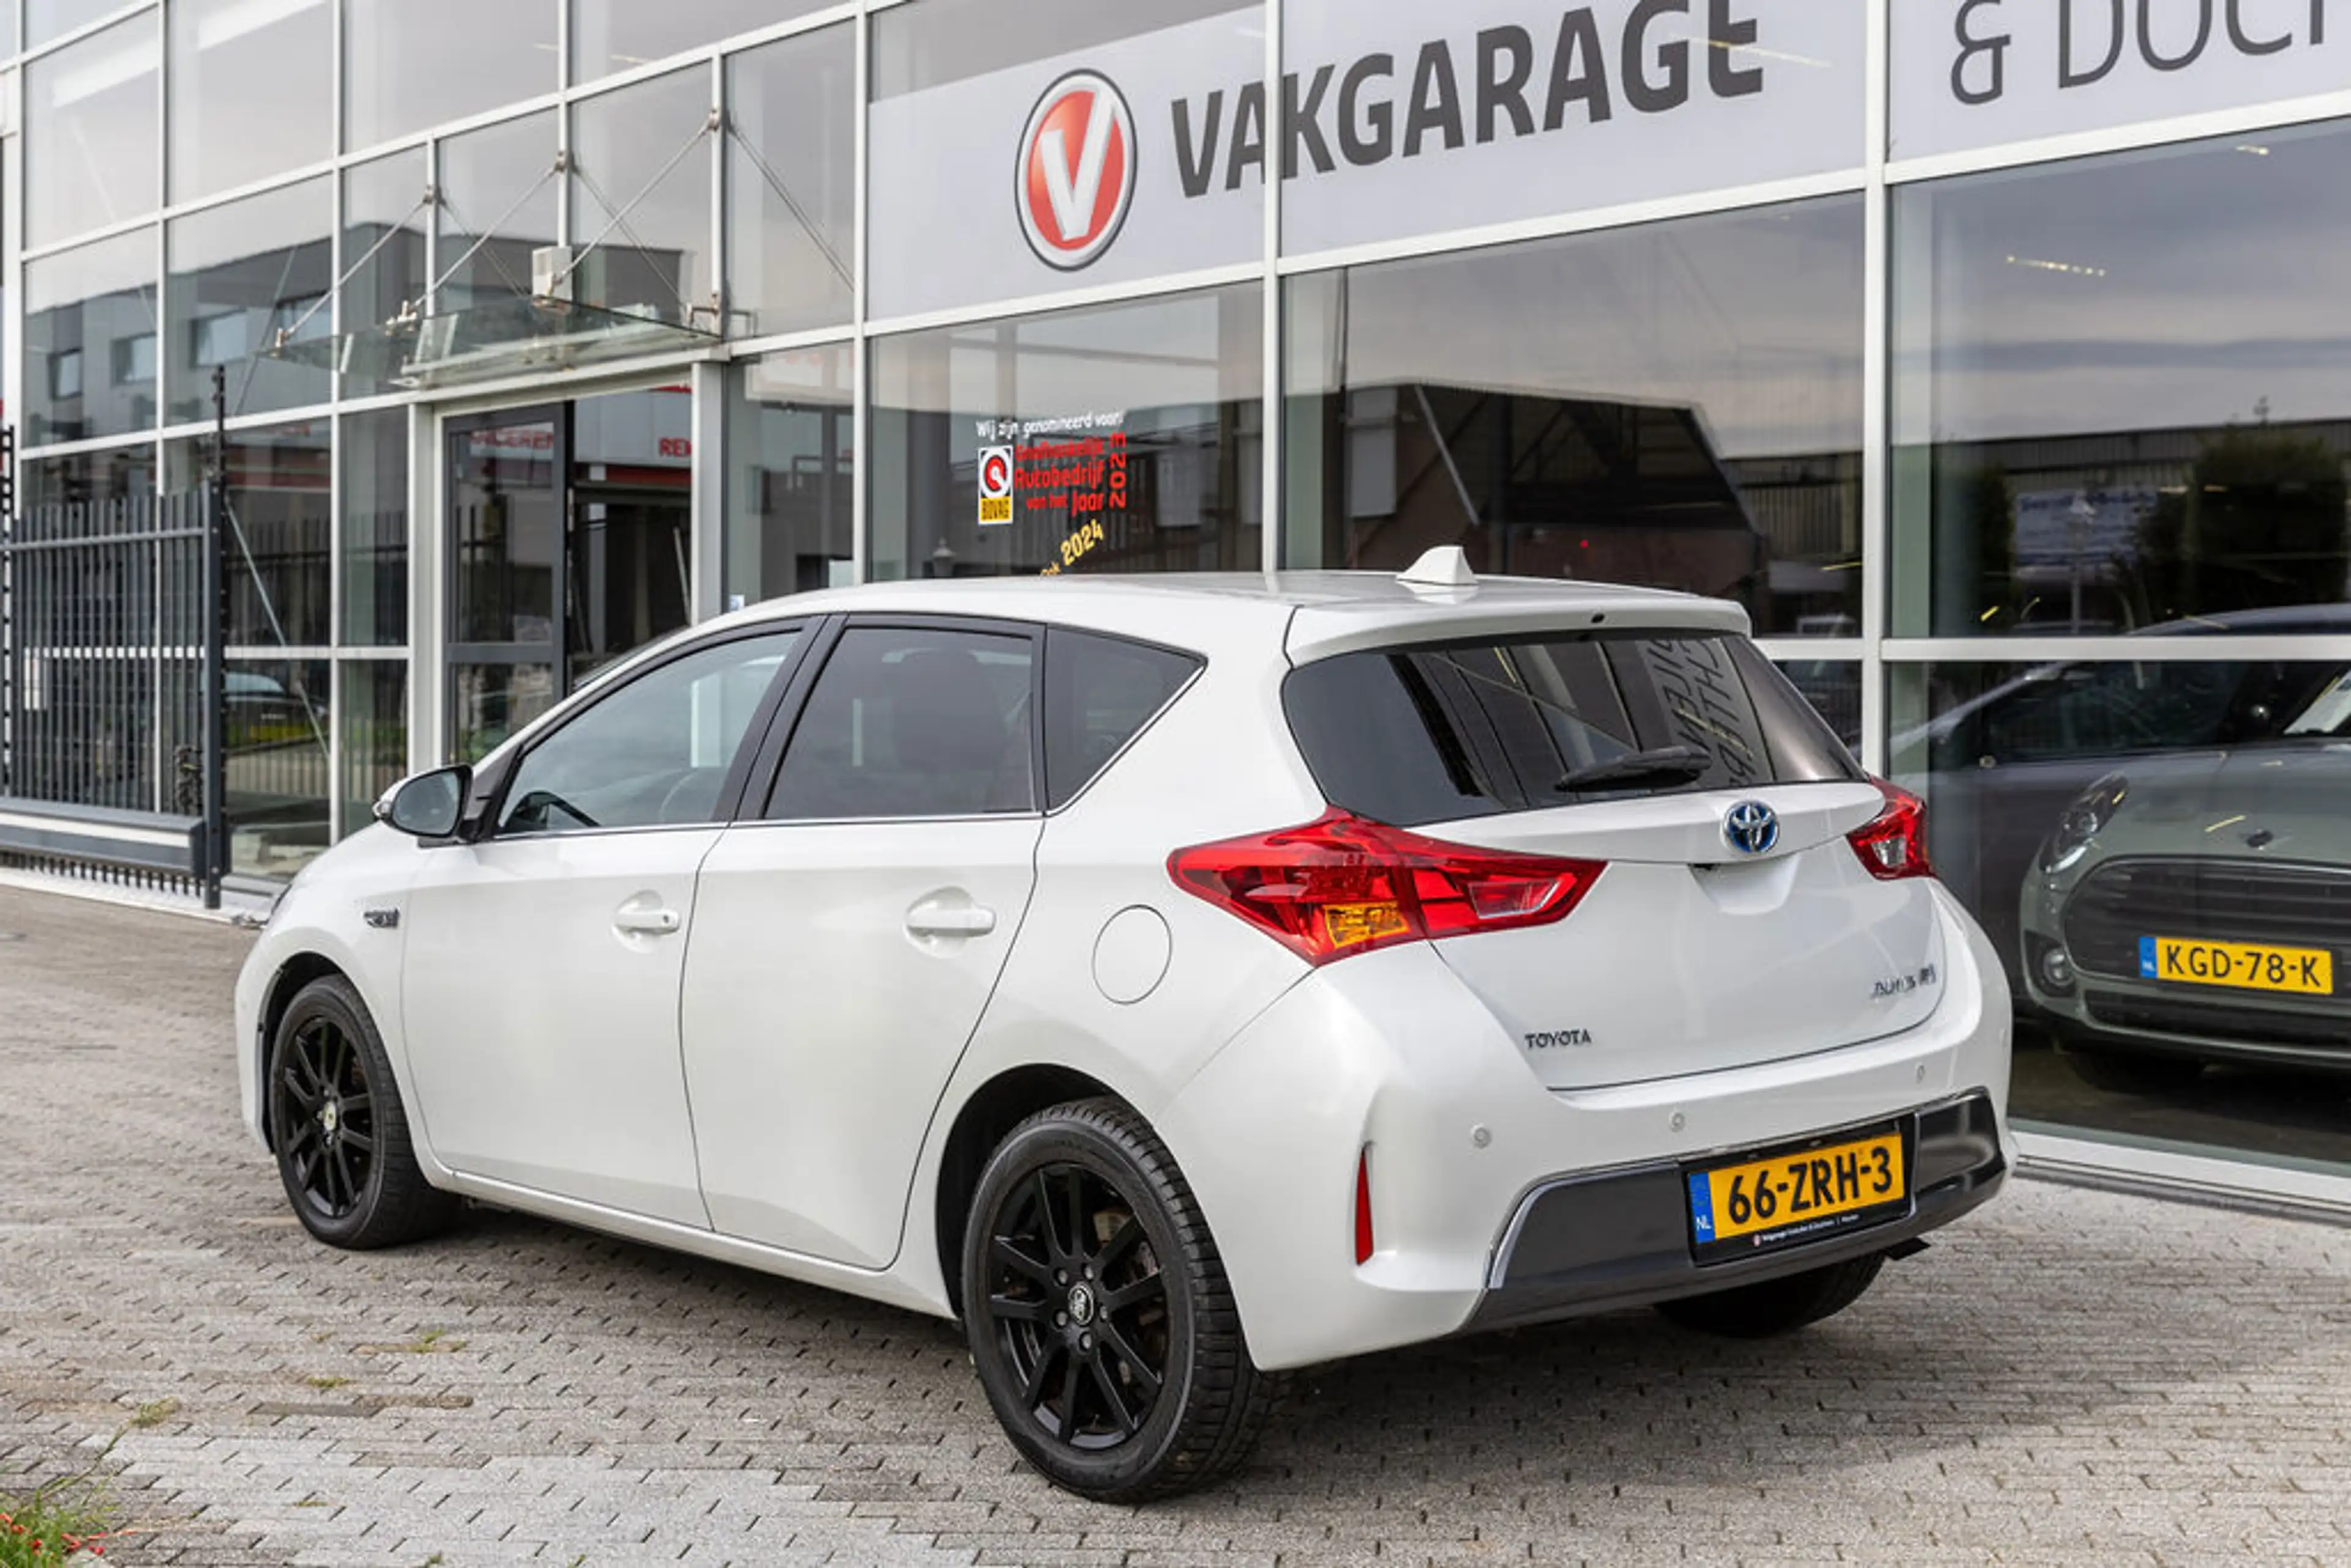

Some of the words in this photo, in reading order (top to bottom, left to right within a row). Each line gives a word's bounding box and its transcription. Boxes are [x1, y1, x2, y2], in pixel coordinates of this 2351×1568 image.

[1951, 0, 2011, 104] &
[1171, 0, 1763, 198] VAKGARAGE
[1014, 460, 1104, 490] Autobedrijf
[1109, 431, 1127, 509] 2023
[1060, 519, 1103, 566] 2024
[2166, 945, 2320, 987] KGD-78-K
[1524, 1029, 1592, 1050] TOYOTA
[1728, 1146, 1893, 1225] 66-ZRH-3
[1697, 1214, 1711, 1231] NL
